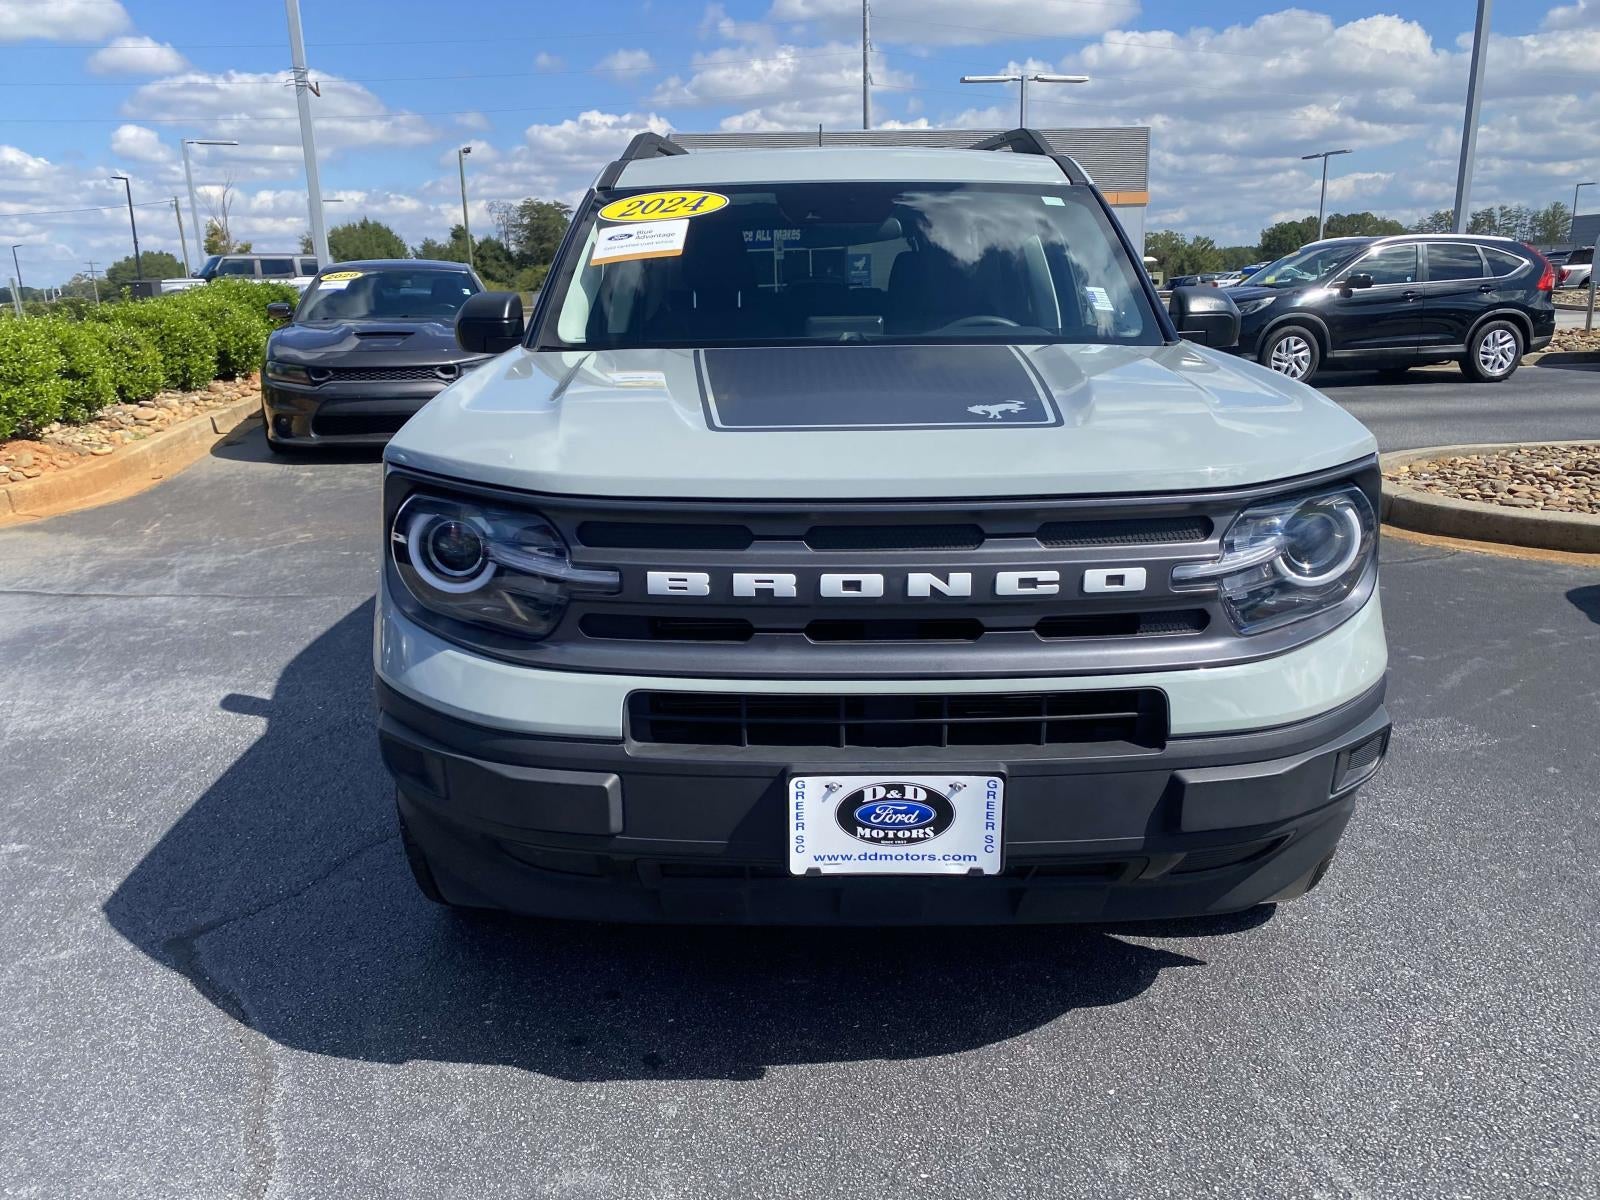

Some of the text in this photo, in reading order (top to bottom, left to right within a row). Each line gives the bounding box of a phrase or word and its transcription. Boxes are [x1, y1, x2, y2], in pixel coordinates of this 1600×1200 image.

[617, 195, 710, 218] 2024
[635, 232, 676, 241] Advantage
[755, 229, 772, 241] ALL
[326, 272, 359, 280] 2020
[646, 566, 1148, 598] BRONCO
[862, 784, 928, 803] D&D
[794, 780, 806, 854] GREER SC
[870, 804, 920, 824] Ford
[984, 779, 998, 854] GREER SC
[856, 826, 935, 839] MOTORS
[813, 851, 978, 863] www.ddmotors.com
